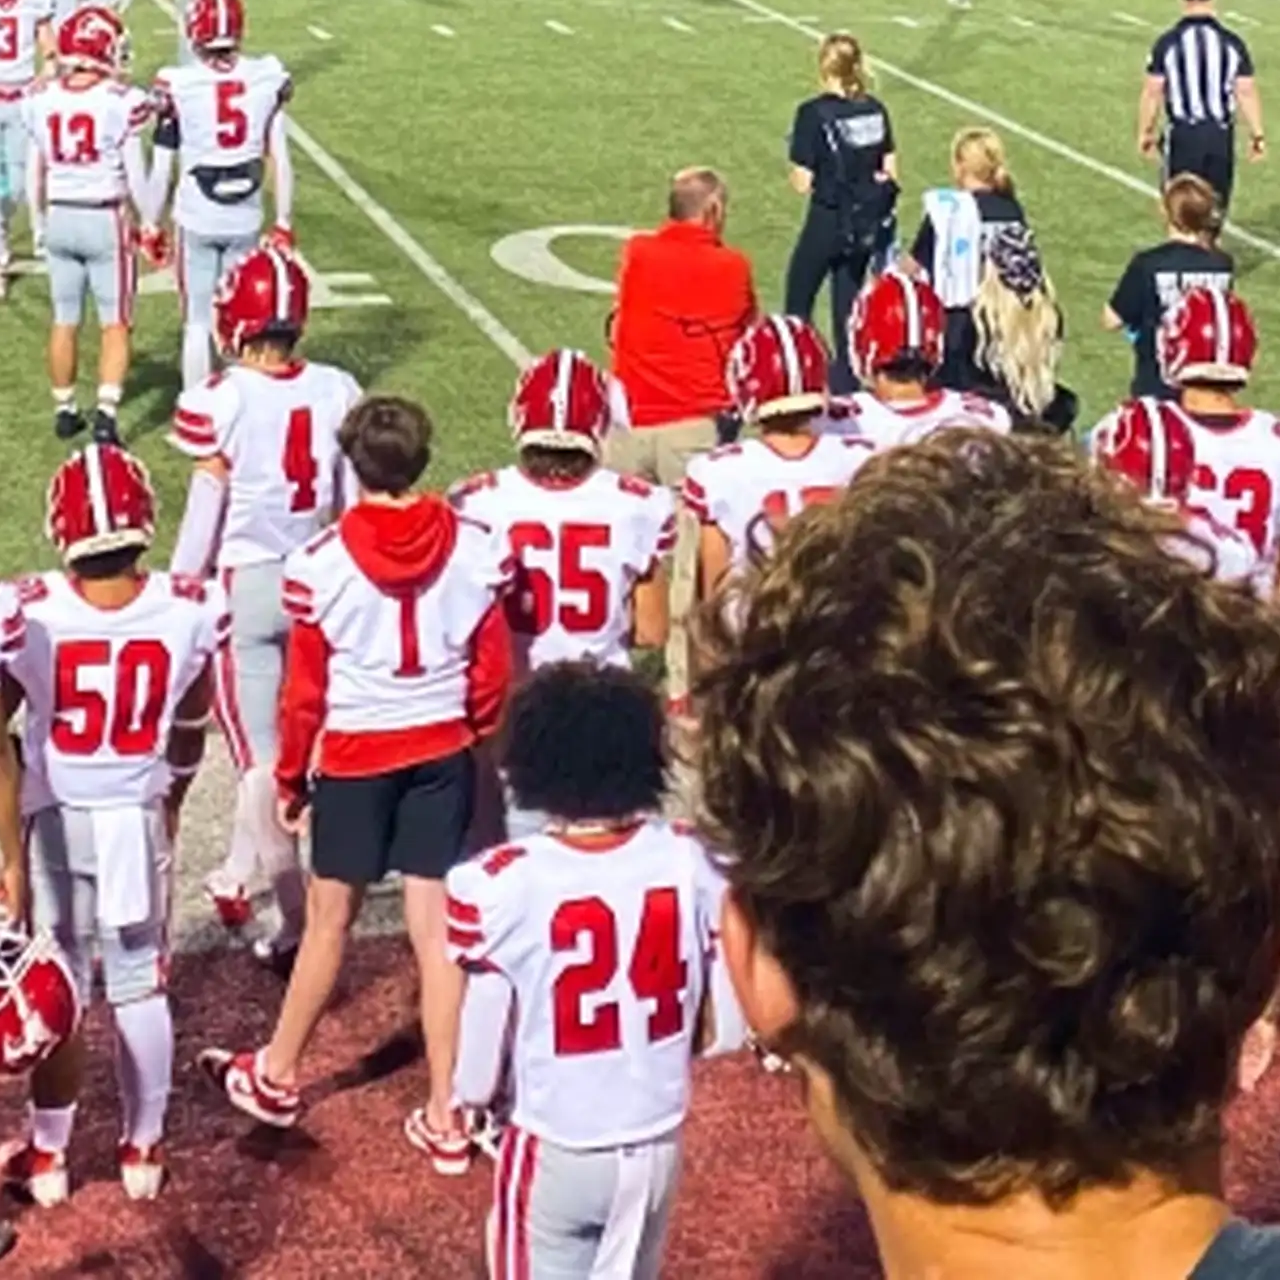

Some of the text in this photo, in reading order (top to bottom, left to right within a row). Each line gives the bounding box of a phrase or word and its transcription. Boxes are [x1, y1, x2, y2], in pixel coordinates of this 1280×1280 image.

[214, 80, 249, 150] 5
[282, 405, 320, 513] 4
[507, 520, 612, 635] 65
[50, 638, 173, 757] 50
[549, 886, 688, 1055] 24
